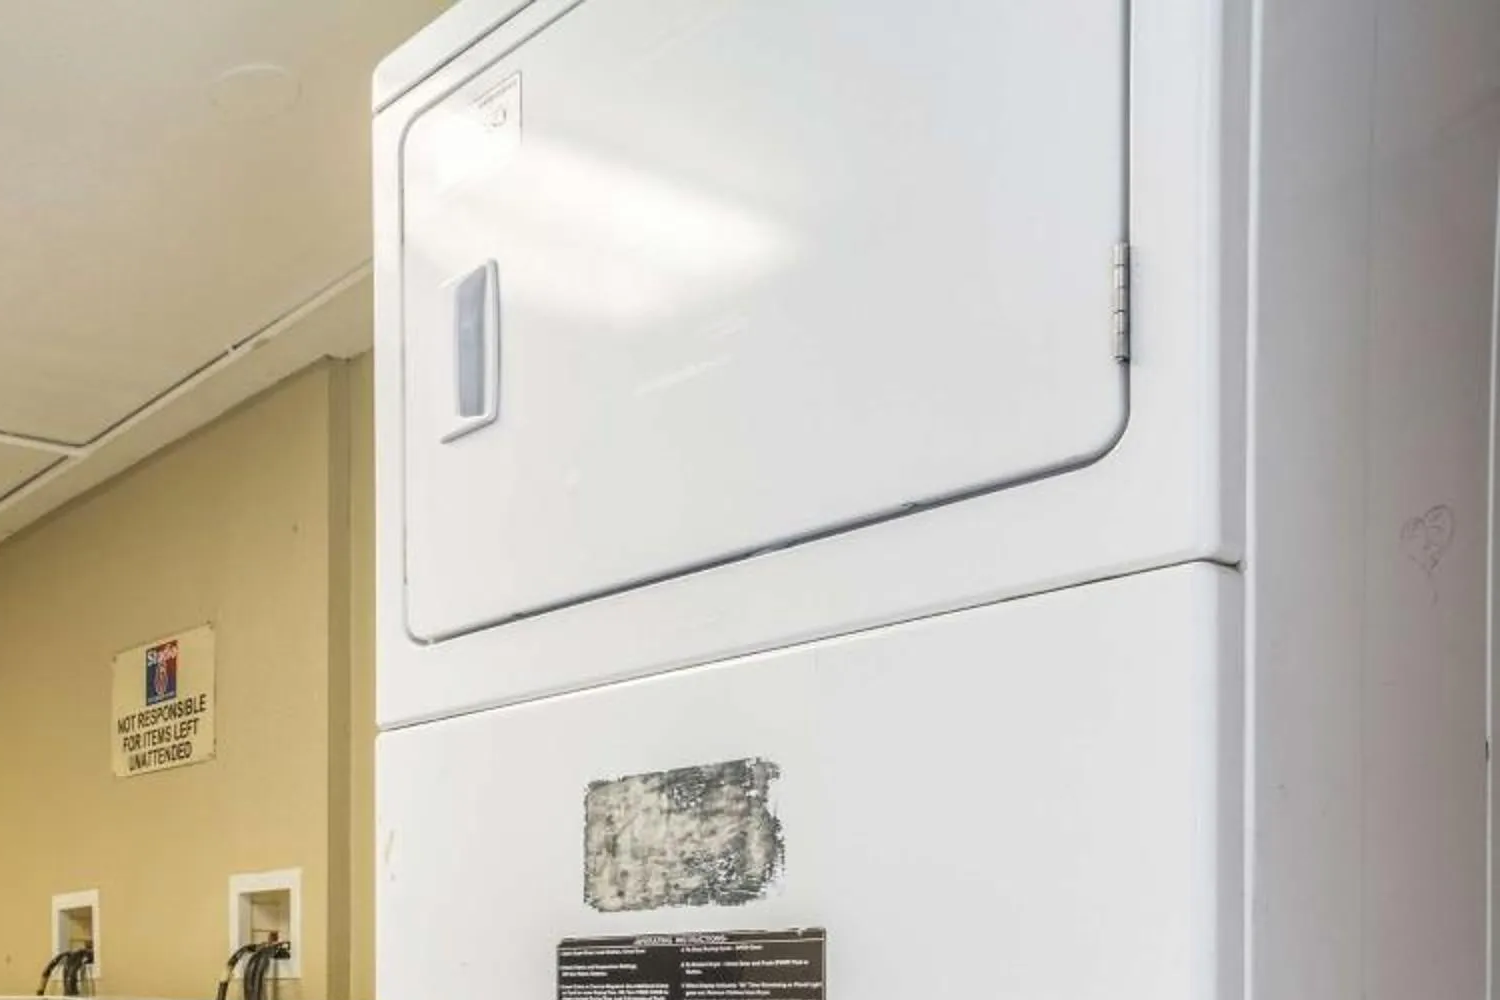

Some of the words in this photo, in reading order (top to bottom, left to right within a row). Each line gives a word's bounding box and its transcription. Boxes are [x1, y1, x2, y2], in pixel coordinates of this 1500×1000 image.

[118, 715, 136, 734] NOT
[137, 693, 206, 729] RESPONSIBLE
[123, 733, 141, 753] FOR
[143, 725, 172, 749] ITEMS
[174, 717, 200, 741] LEFT
[129, 740, 193, 772] UNATTENDED
